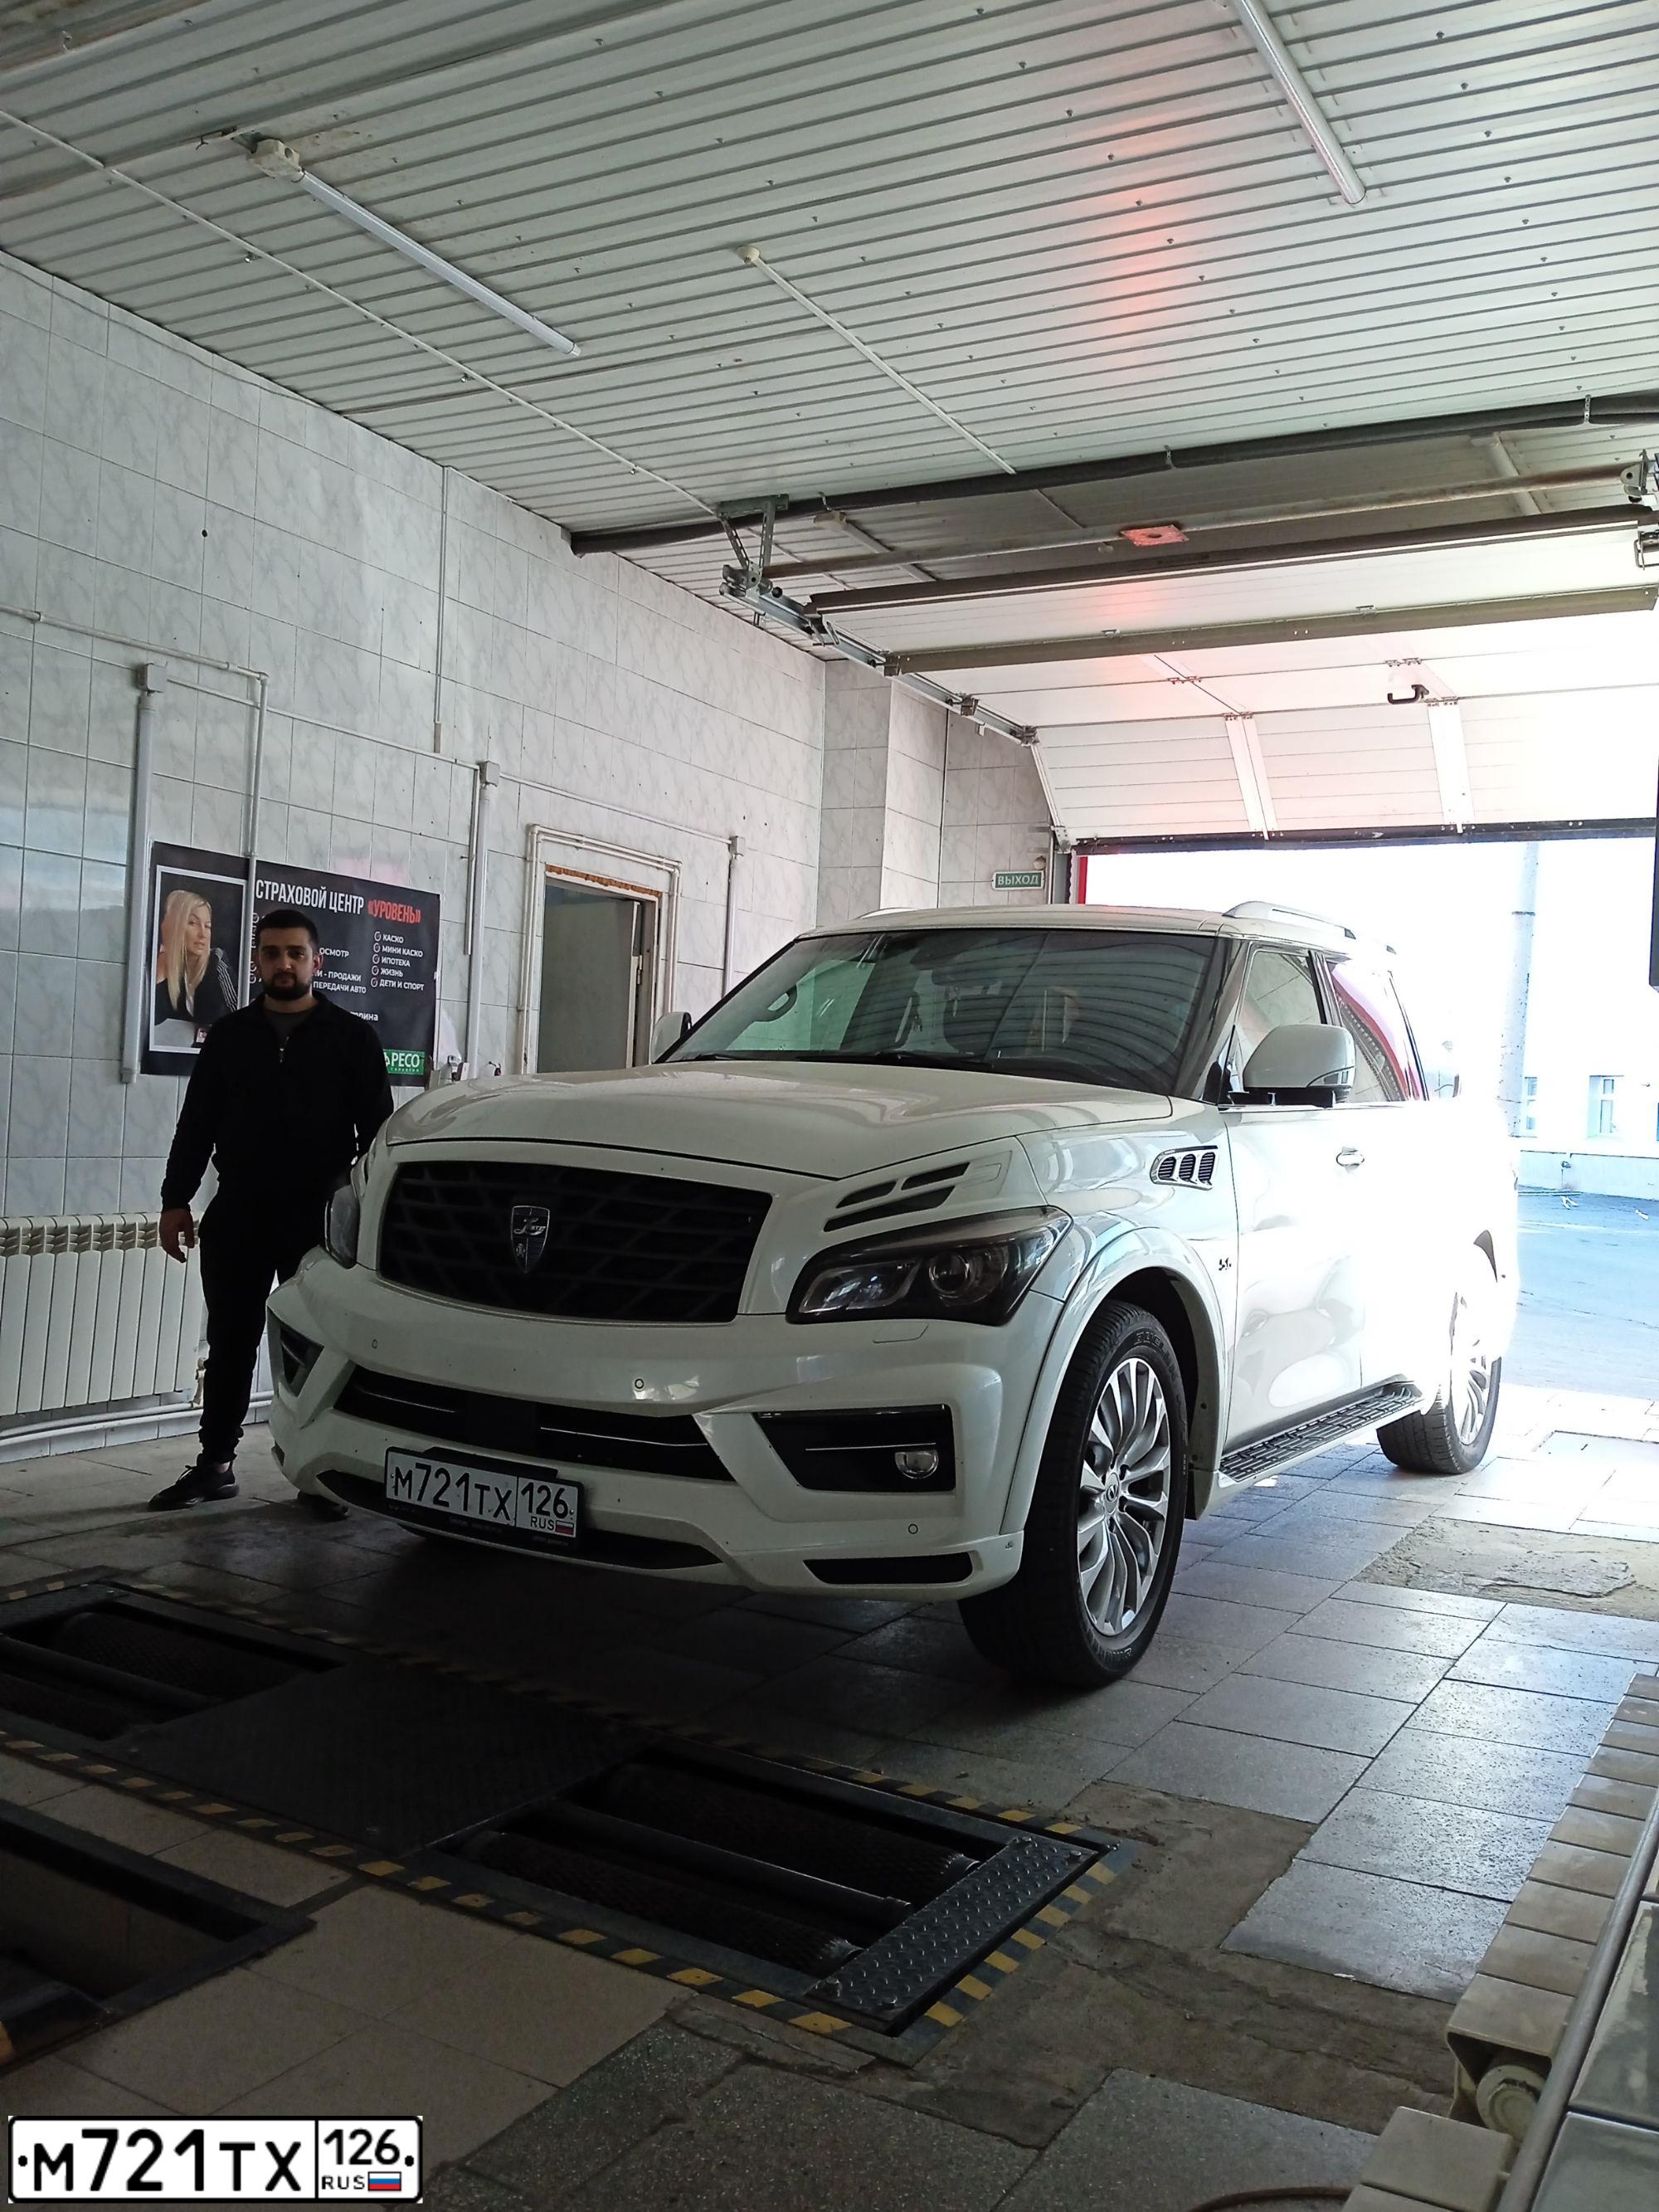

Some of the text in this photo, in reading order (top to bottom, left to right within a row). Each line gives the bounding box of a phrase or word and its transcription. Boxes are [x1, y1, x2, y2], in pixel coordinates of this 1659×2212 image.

[997, 875, 1039, 885] ВЫХОД
[255, 879, 421, 924] СТРАХОВОЙ ЦЕНТР «УРОВЕНЬ»
[382, 933, 404, 943] КАСКО
[319, 947, 349, 957] ОСМОТР
[382, 944, 424, 957] МИНИ КАСКО
[381, 956, 411, 967] ИПОТЕКА
[328, 971, 362, 982] ПРОДАЖИ
[380, 967, 404, 977] ЖИЗНЬ
[313, 981, 367, 994] ПЕРЕДАЧИ АВТО
[379, 978, 397, 988] ДЕТИ
[403, 982, 425, 992] СПОРТ
[391, 1052, 421, 1068] РЕСО
[520, 1481, 569, 1519] 126
[530, 1517, 555, 1531] RUS
